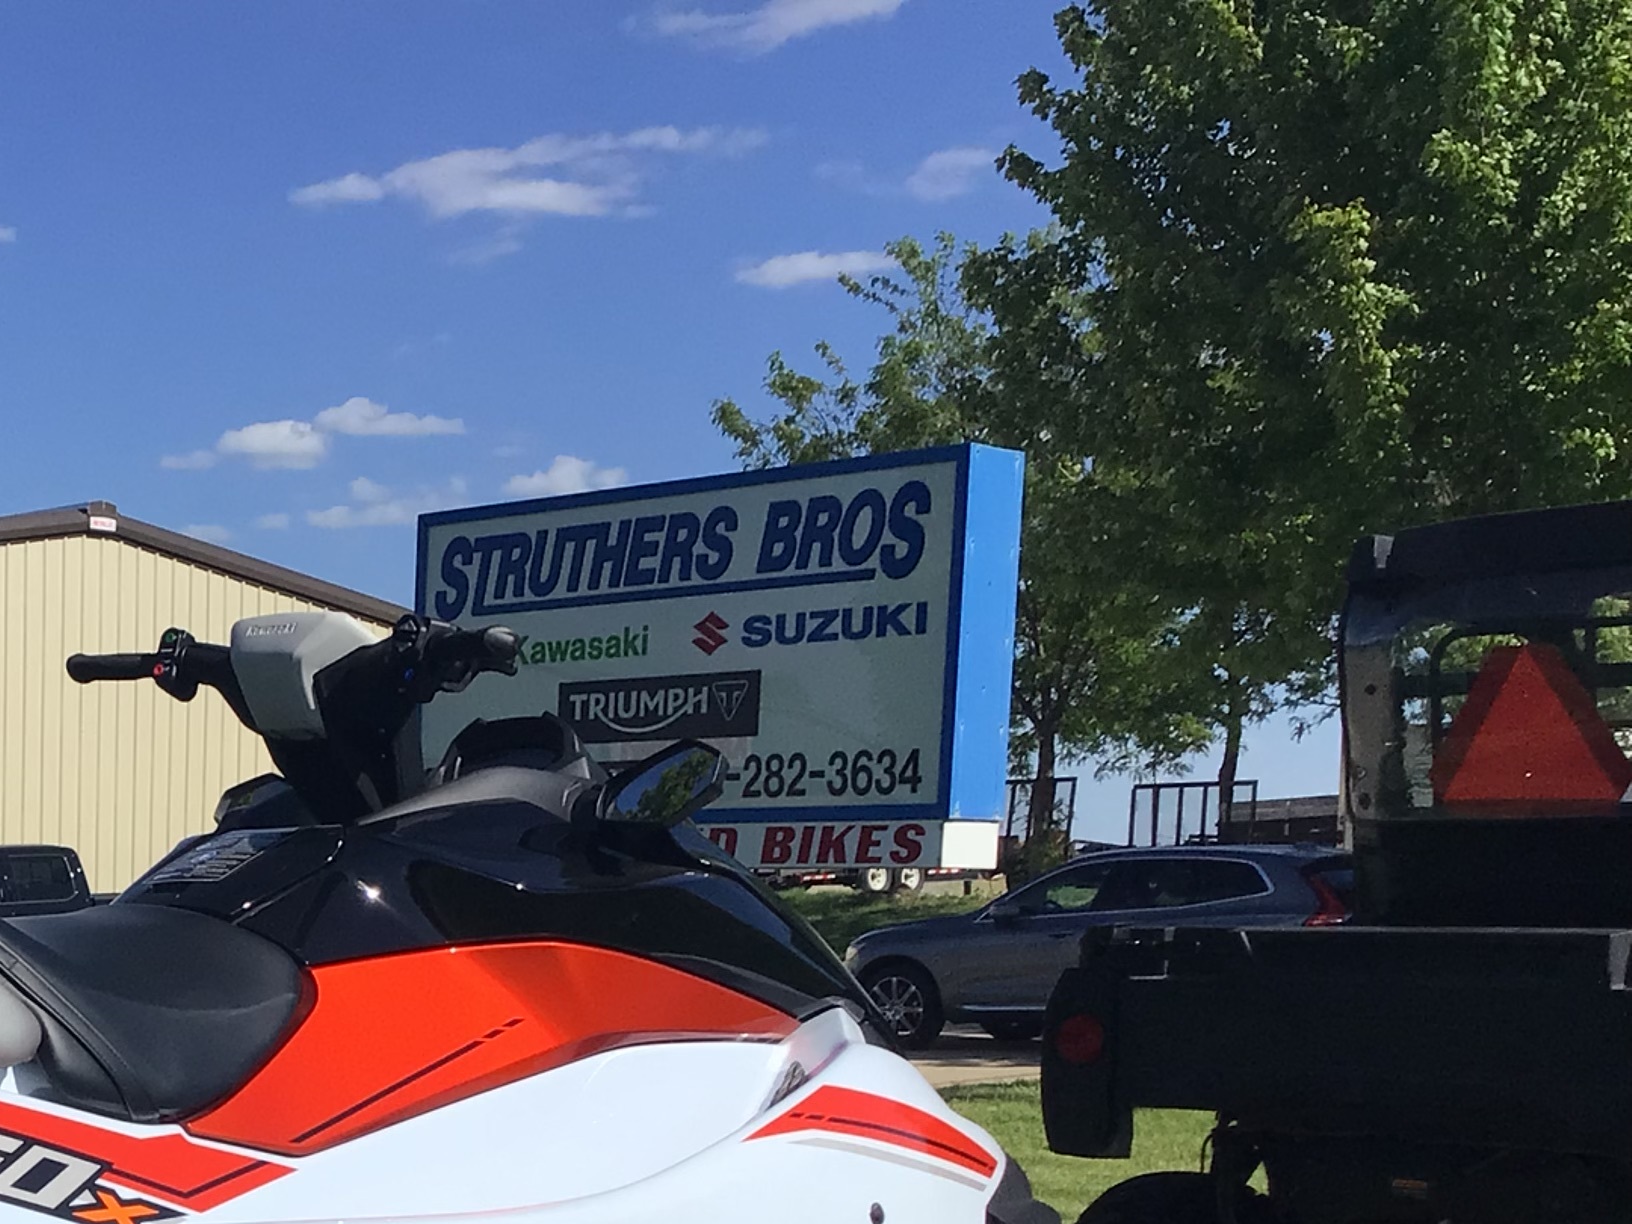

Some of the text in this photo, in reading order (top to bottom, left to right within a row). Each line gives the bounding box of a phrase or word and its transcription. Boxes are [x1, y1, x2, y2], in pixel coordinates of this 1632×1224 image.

[434, 480, 931, 622] STRUTHERS BROS
[516, 625, 649, 665] Kawasaki
[741, 602, 928, 648] SUZUKI
[569, 686, 708, 734] TRIUMPH
[760, 823, 926, 865] BIKES
